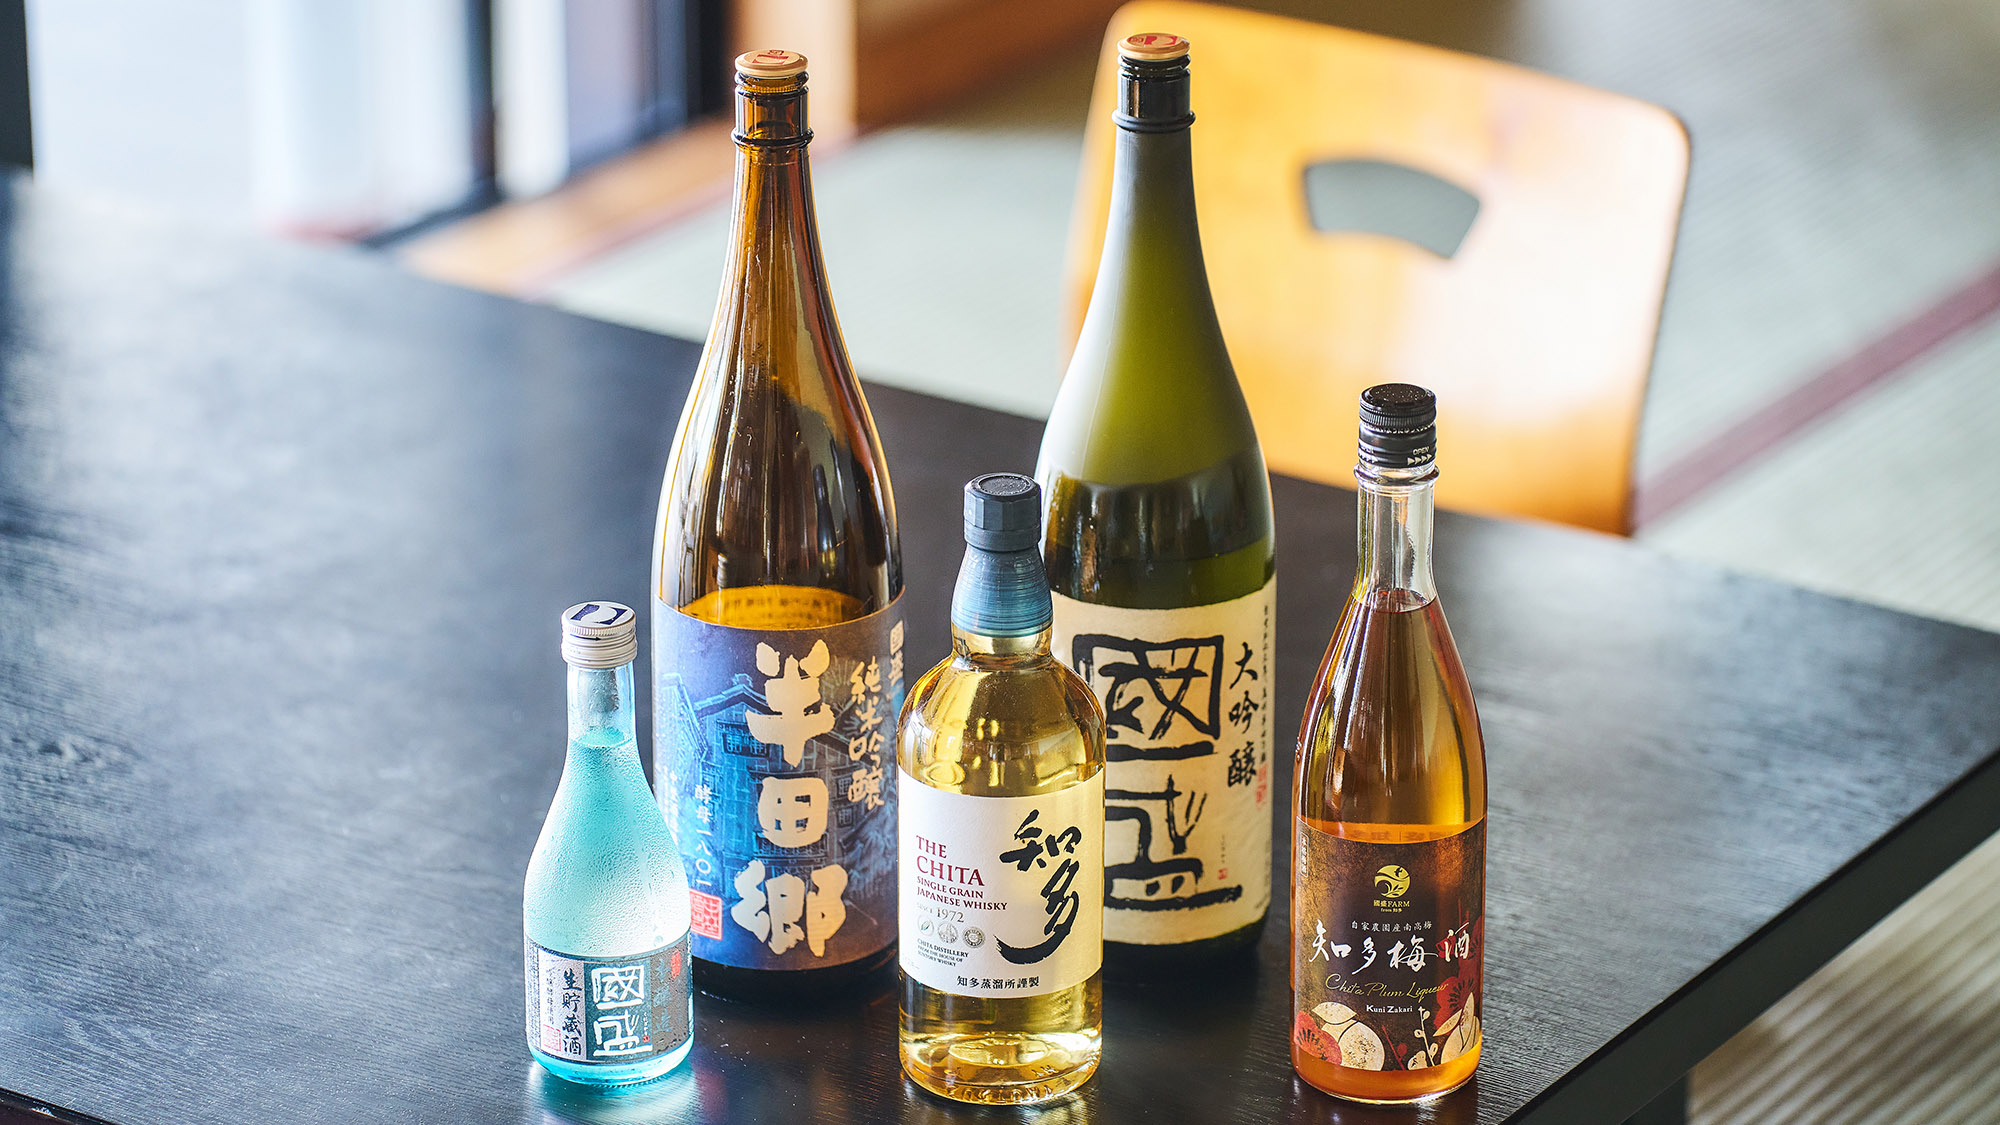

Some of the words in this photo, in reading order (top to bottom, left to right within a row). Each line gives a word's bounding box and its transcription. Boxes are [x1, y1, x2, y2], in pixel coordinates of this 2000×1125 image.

[915, 834, 947, 859] THE
[916, 855, 985, 887] CHITA
[917, 875, 947, 893] SINGLE
[948, 887, 984, 899] GRAIN
[917, 886, 961, 907] JAPANESE
[963, 899, 1008, 911] WHISKY
[992, 808, 1082, 966] 知多
[936, 907, 965, 923] 1972
[934, 945, 969, 957] DISTILLERY
[1308, 918, 1470, 975] 知多梅酒
[1325, 973, 1365, 996] Chita
[1364, 982, 1404, 997] Plum
[1406, 981, 1449, 1003] Liqueur
[1366, 1004, 1386, 1013] Kuni
[1387, 1005, 1413, 1014] Zakari
